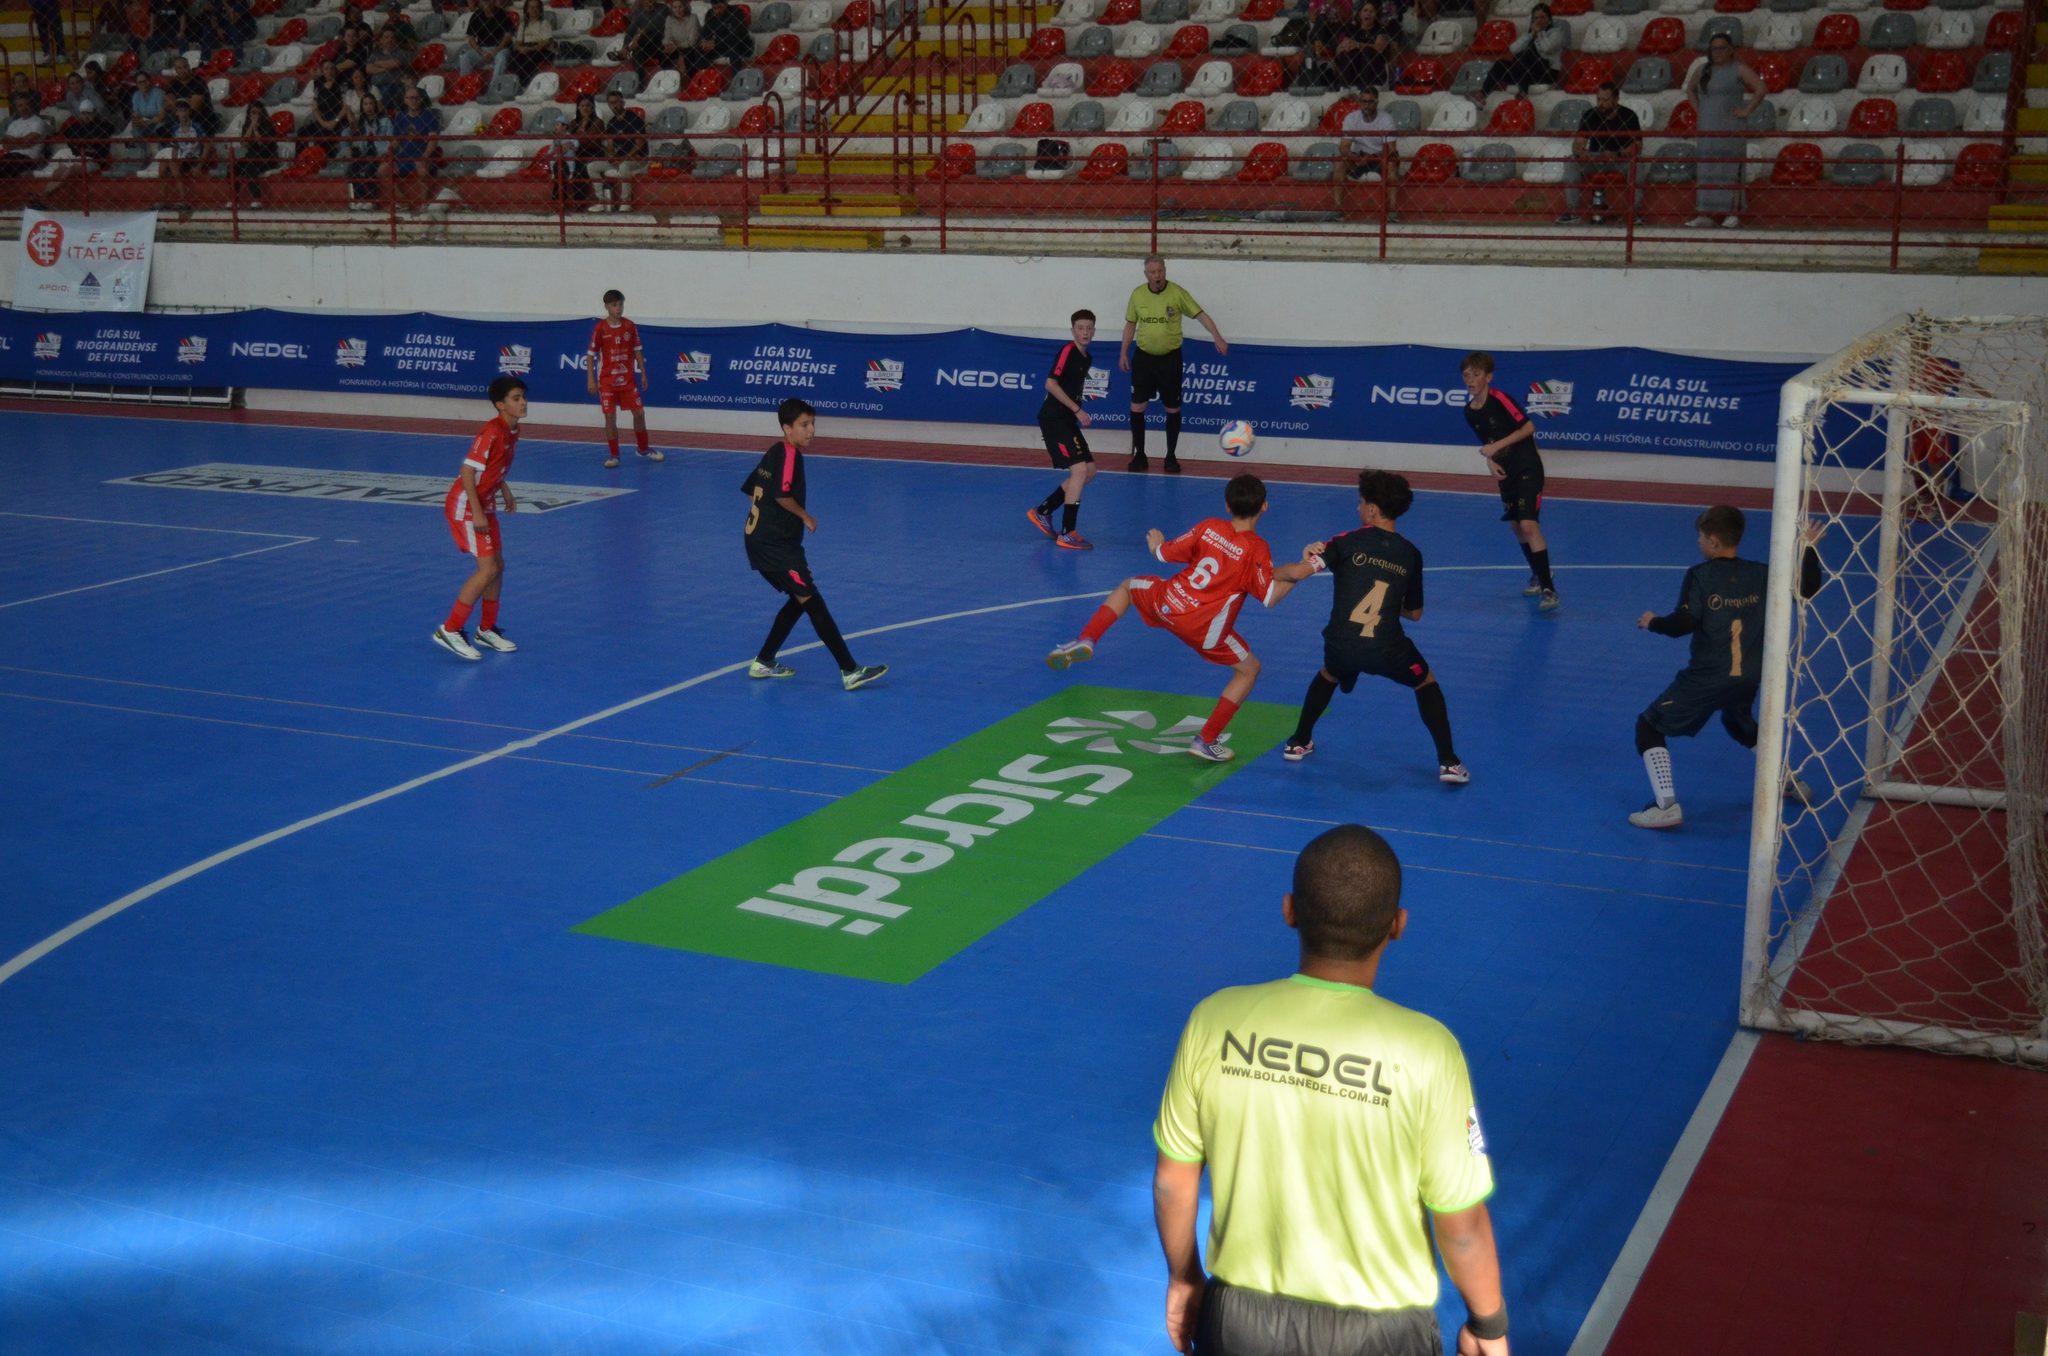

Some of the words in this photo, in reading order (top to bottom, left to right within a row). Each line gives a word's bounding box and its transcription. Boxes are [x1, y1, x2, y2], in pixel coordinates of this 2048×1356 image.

[88, 232, 104, 243] E.
[113, 232, 130, 243] C.
[67, 243, 145, 260] ITAPAGÉ
[97, 329, 119, 339] LIGA
[122, 330, 141, 340] SUL
[405, 334, 432, 345] LIGA
[435, 336, 456, 346] SUL
[76, 341, 158, 352] RIOGRANDENSE
[232, 342, 308, 358] NEDEL
[383, 346, 476, 360] RIOGRANDENSE
[754, 346, 786, 357] LIGA
[789, 347, 813, 359] SUL
[88, 353, 101, 362] DE
[103, 353, 142, 363] FUTSAL
[397, 360, 412, 370] DE
[415, 361, 459, 372] FUTSAL
[729, 360, 836, 375] RIOGRANDENSE
[1200, 363, 1229, 376] SUL
[339, 378, 380, 387] HONRANDO
[388, 379, 419, 388] HISTÓRIA
[426, 382, 477, 392] CONSTRUINDO
[745, 373, 763, 384] DE
[765, 374, 815, 387] FUTSAL
[936, 369, 1033, 390] NEDEL
[1629, 373, 1671, 390] LIGA
[1675, 379, 1709, 393] SUL
[679, 394, 726, 403] HONRANDO
[735, 395, 770, 405] HISTÓRIA
[850, 402, 883, 411] FUTURO
[1182, 392, 1232, 406] UTSAL
[1371, 385, 1474, 406] NEDE
[1596, 389, 1740, 410] RIOGRANDENSE
[1617, 407, 1640, 420] DE
[1644, 408, 1712, 424] FUTSAL
[1271, 421, 1309, 431] FUTURO
[1593, 433, 1601, 441] A
[1604, 432, 1650, 444] HISTÓRIA
[1655, 436, 1660, 444] E
[1663, 436, 1741, 450] CONSTRUINDO
[1744, 442, 1753, 451] O
[1204, 528, 1243, 555] PEDRINHO
[1188, 556, 1219, 590] 6
[1368, 557, 1407, 576] requinte
[1348, 579, 1390, 638] 4
[1729, 619, 1743, 677] 1
[736, 753, 1133, 937] Sicredi
[1221, 1029, 1393, 1095] NEDEL
[1221, 1064, 1390, 1108] WWW.BOLASNEDEL.COM.BR
